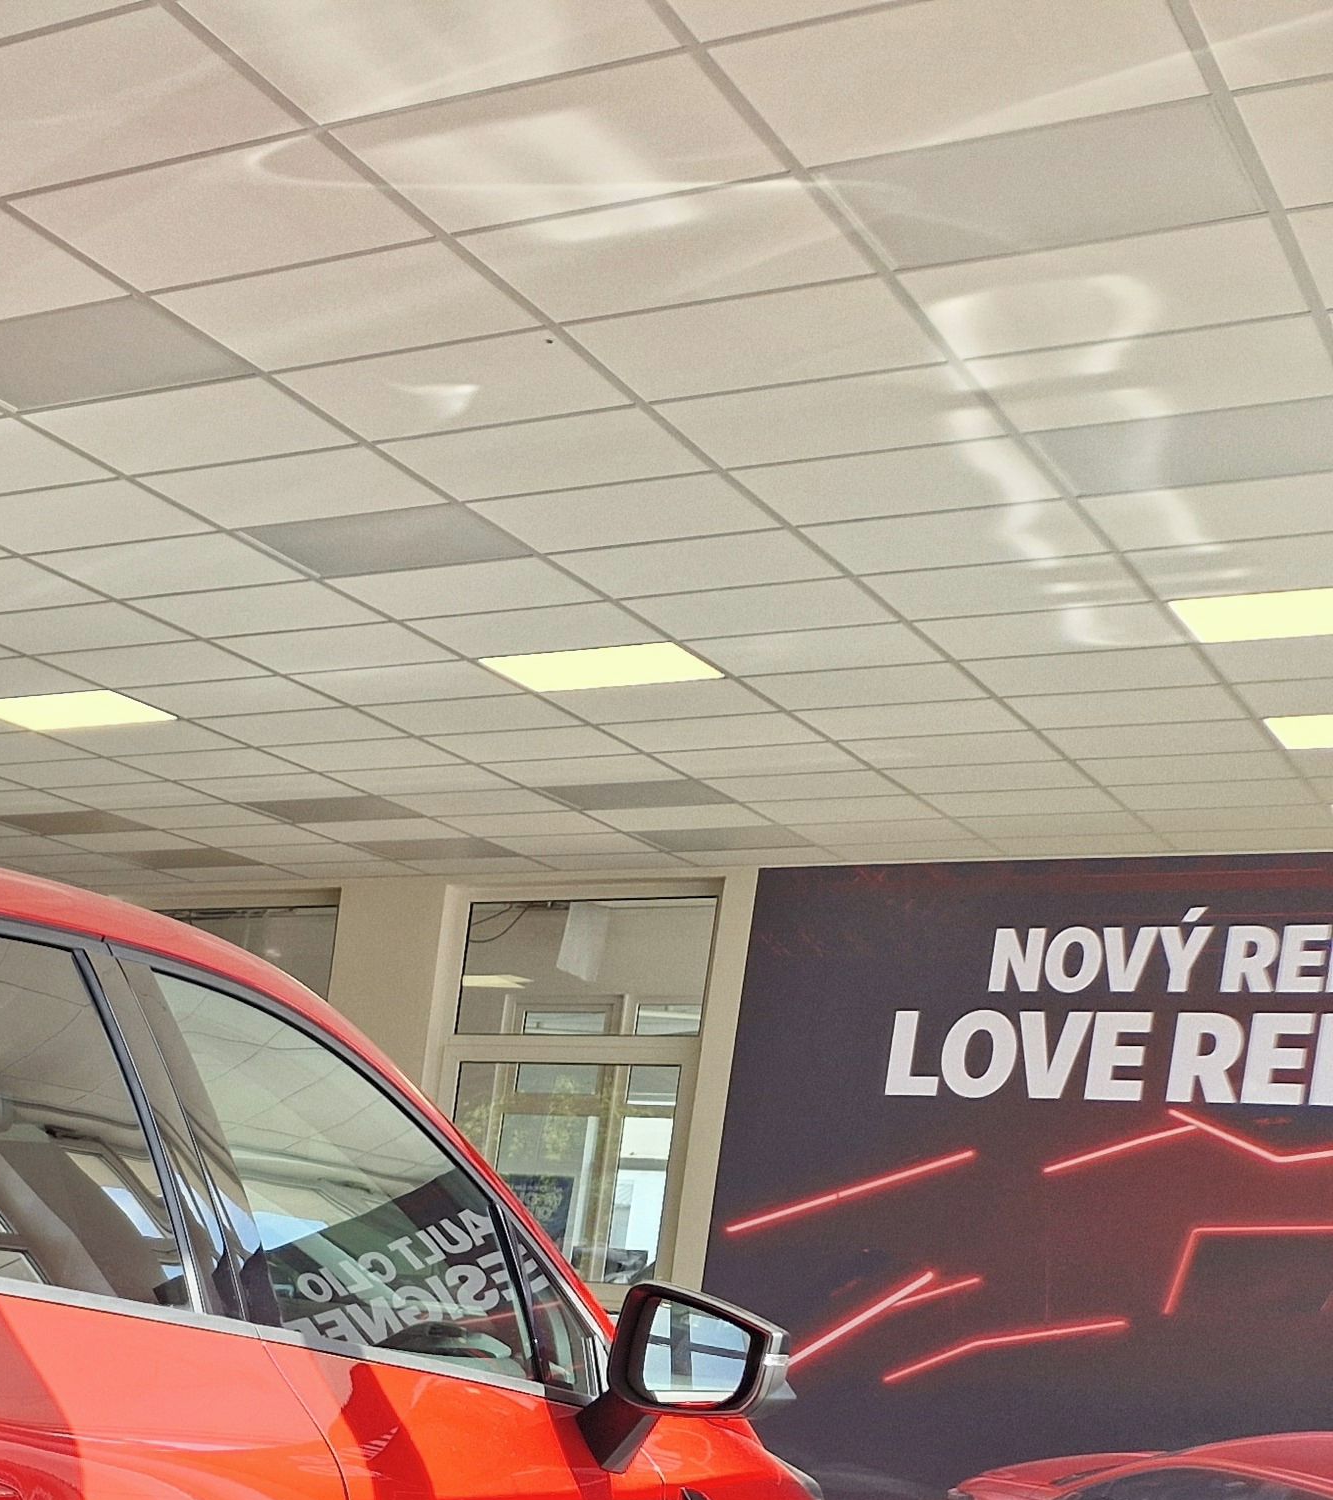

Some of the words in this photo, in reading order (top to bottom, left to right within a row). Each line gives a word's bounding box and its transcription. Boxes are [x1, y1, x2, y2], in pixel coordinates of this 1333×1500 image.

[987, 906, 1211, 993] NOVÝ
[1218, 923, 1333, 994] RE
[884, 1009, 1154, 1100] LOVE
